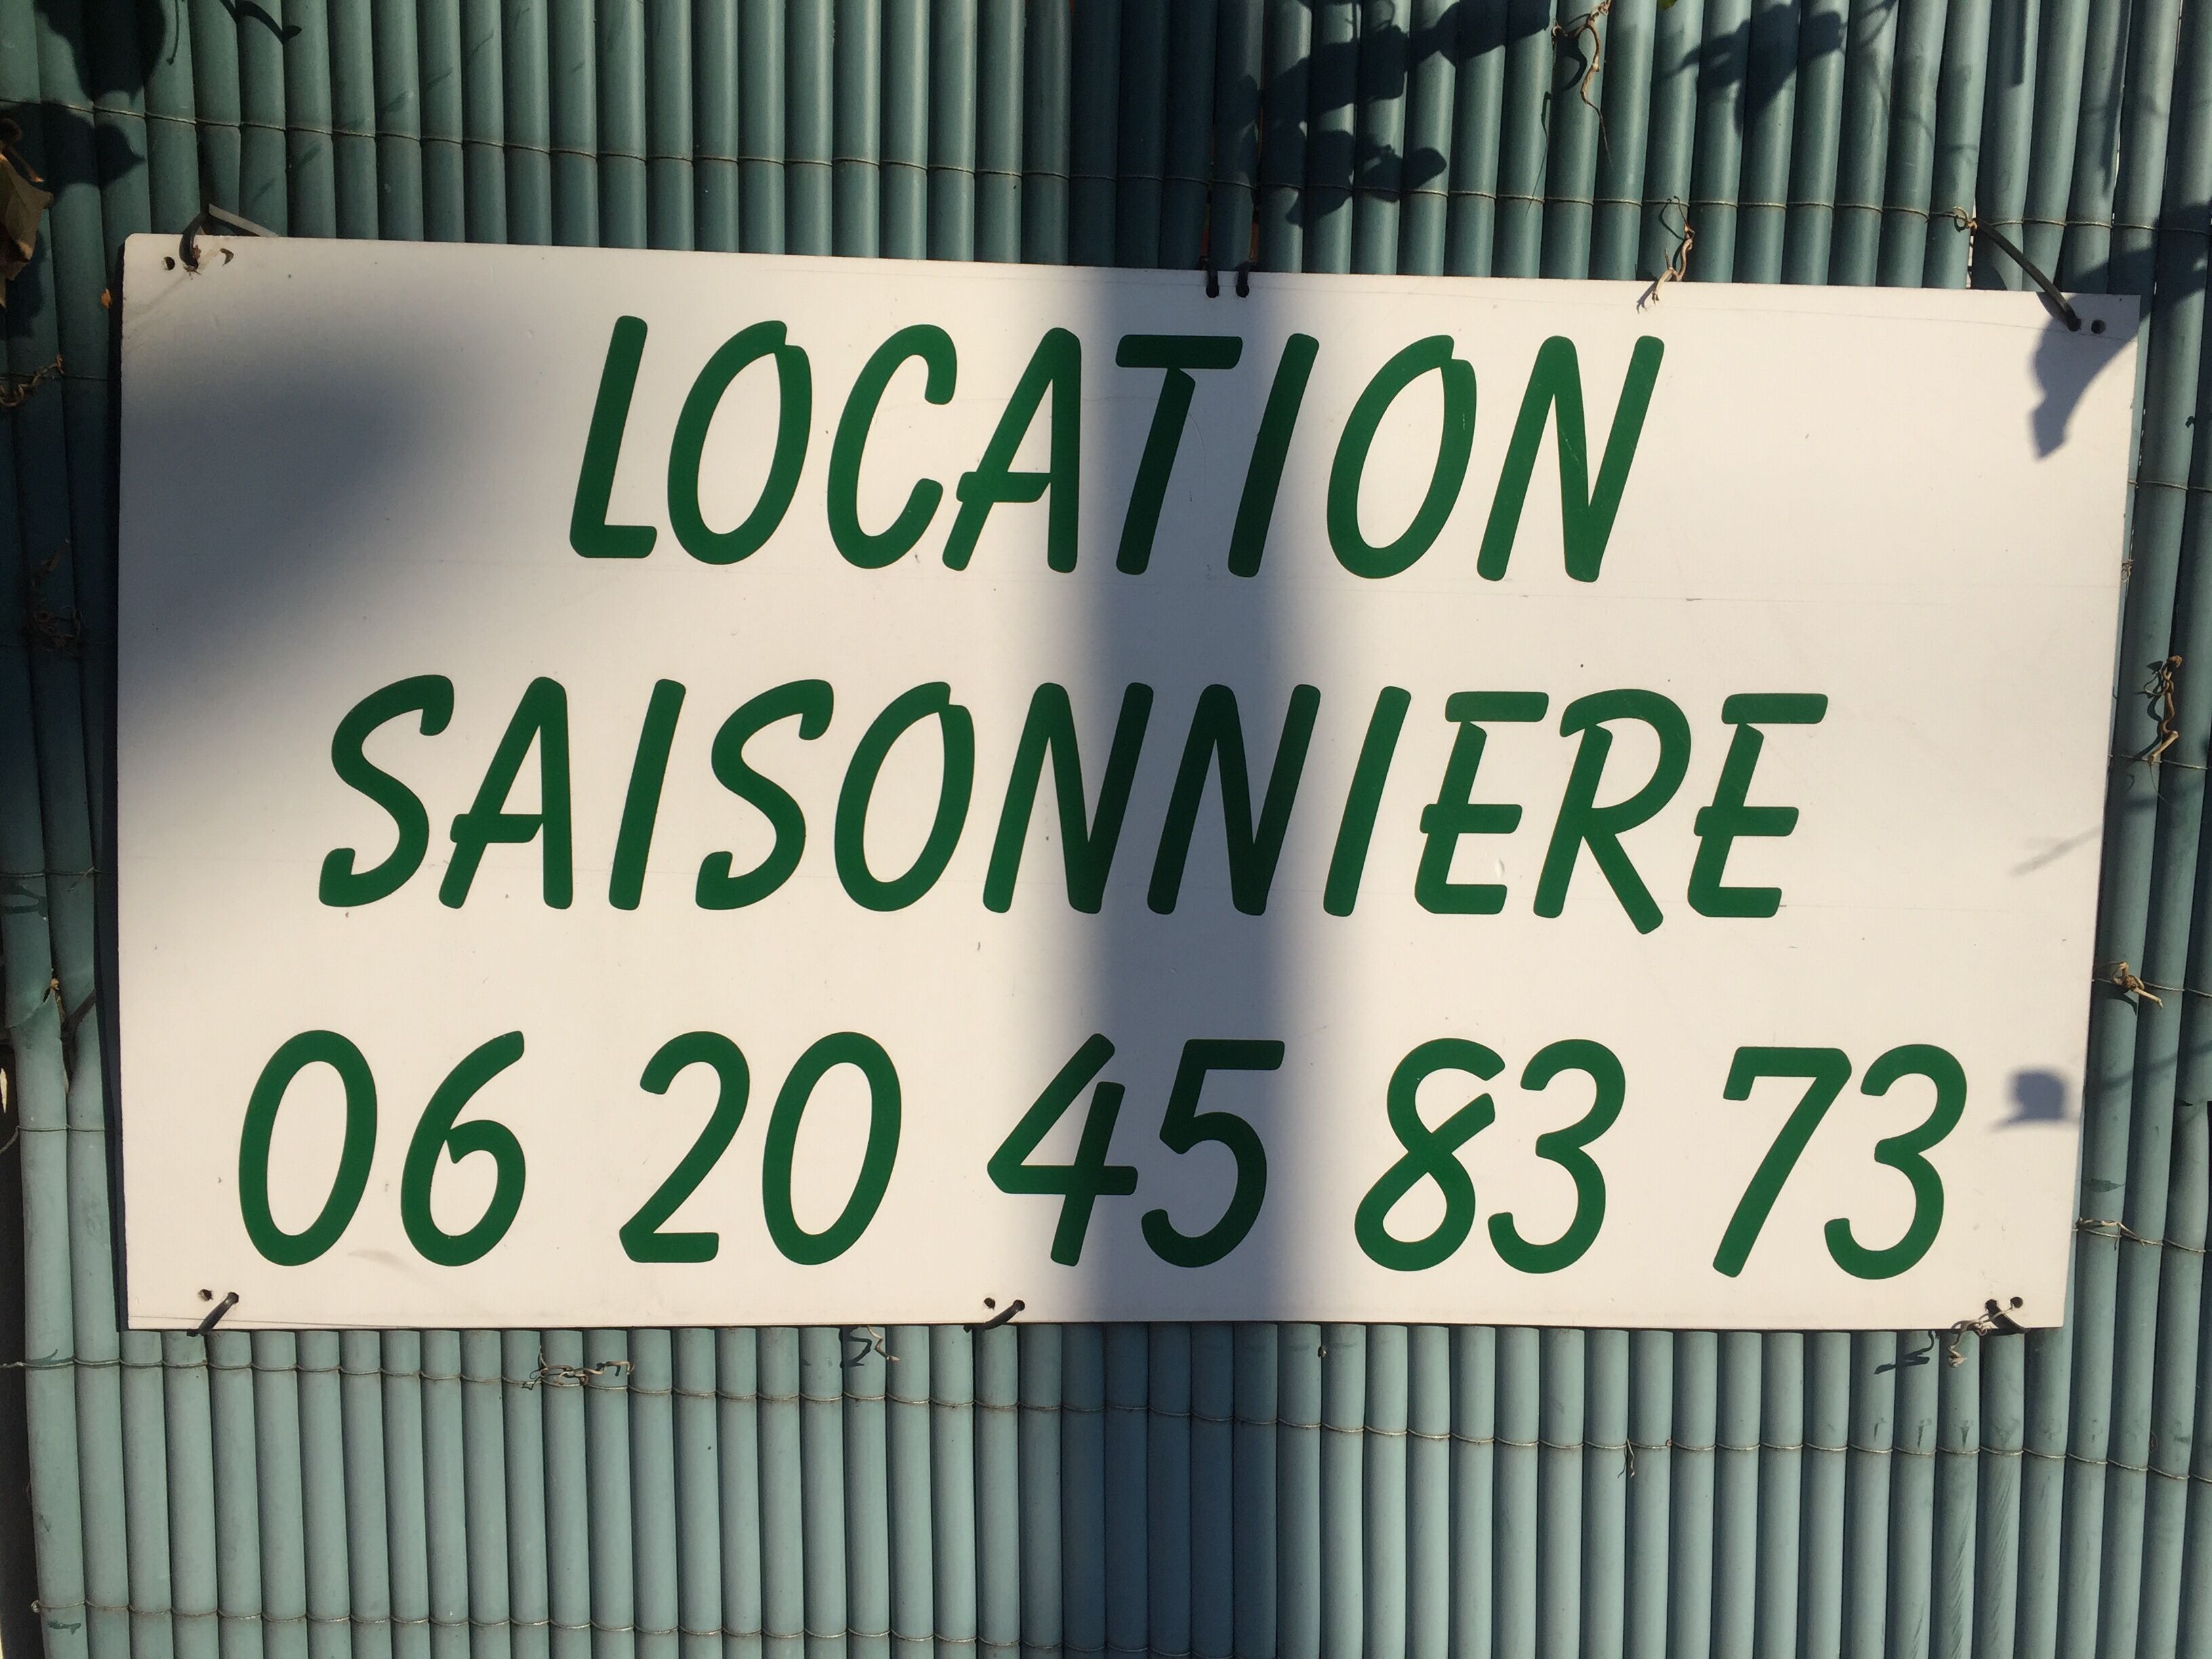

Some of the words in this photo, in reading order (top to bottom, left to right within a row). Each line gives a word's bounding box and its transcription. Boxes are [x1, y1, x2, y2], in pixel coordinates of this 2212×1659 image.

[571, 316, 1665, 582] LOCATION
[319, 675, 1828, 934] SAISONNIERE
[239, 1030, 526, 1267] 06
[619, 1031, 901, 1266] 20
[987, 1033, 1285, 1269] 45
[1355, 1038, 1626, 1275] 83
[1713, 1044, 1968, 1280] 73
